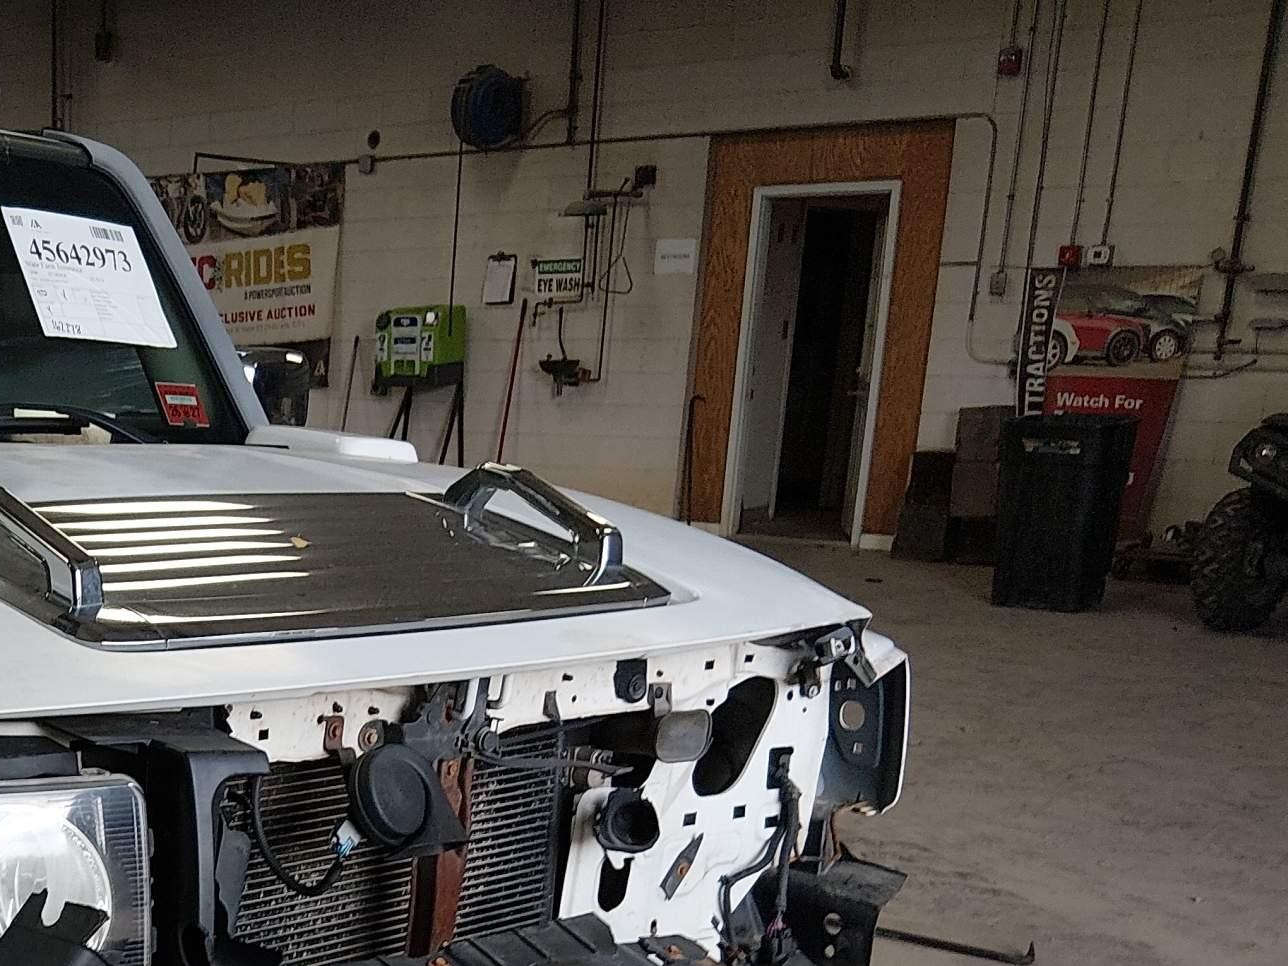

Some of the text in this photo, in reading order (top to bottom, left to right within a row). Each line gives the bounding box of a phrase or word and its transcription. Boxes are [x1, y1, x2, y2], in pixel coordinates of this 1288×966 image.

[29, 238, 132, 273] 45642973
[224, 244, 311, 288] RIDES
[538, 261, 582, 272] EMERGENCY
[537, 277, 581, 292] EYE WASH
[267, 304, 316, 320] AUCTION
[1056, 391, 1144, 410] Watch For
